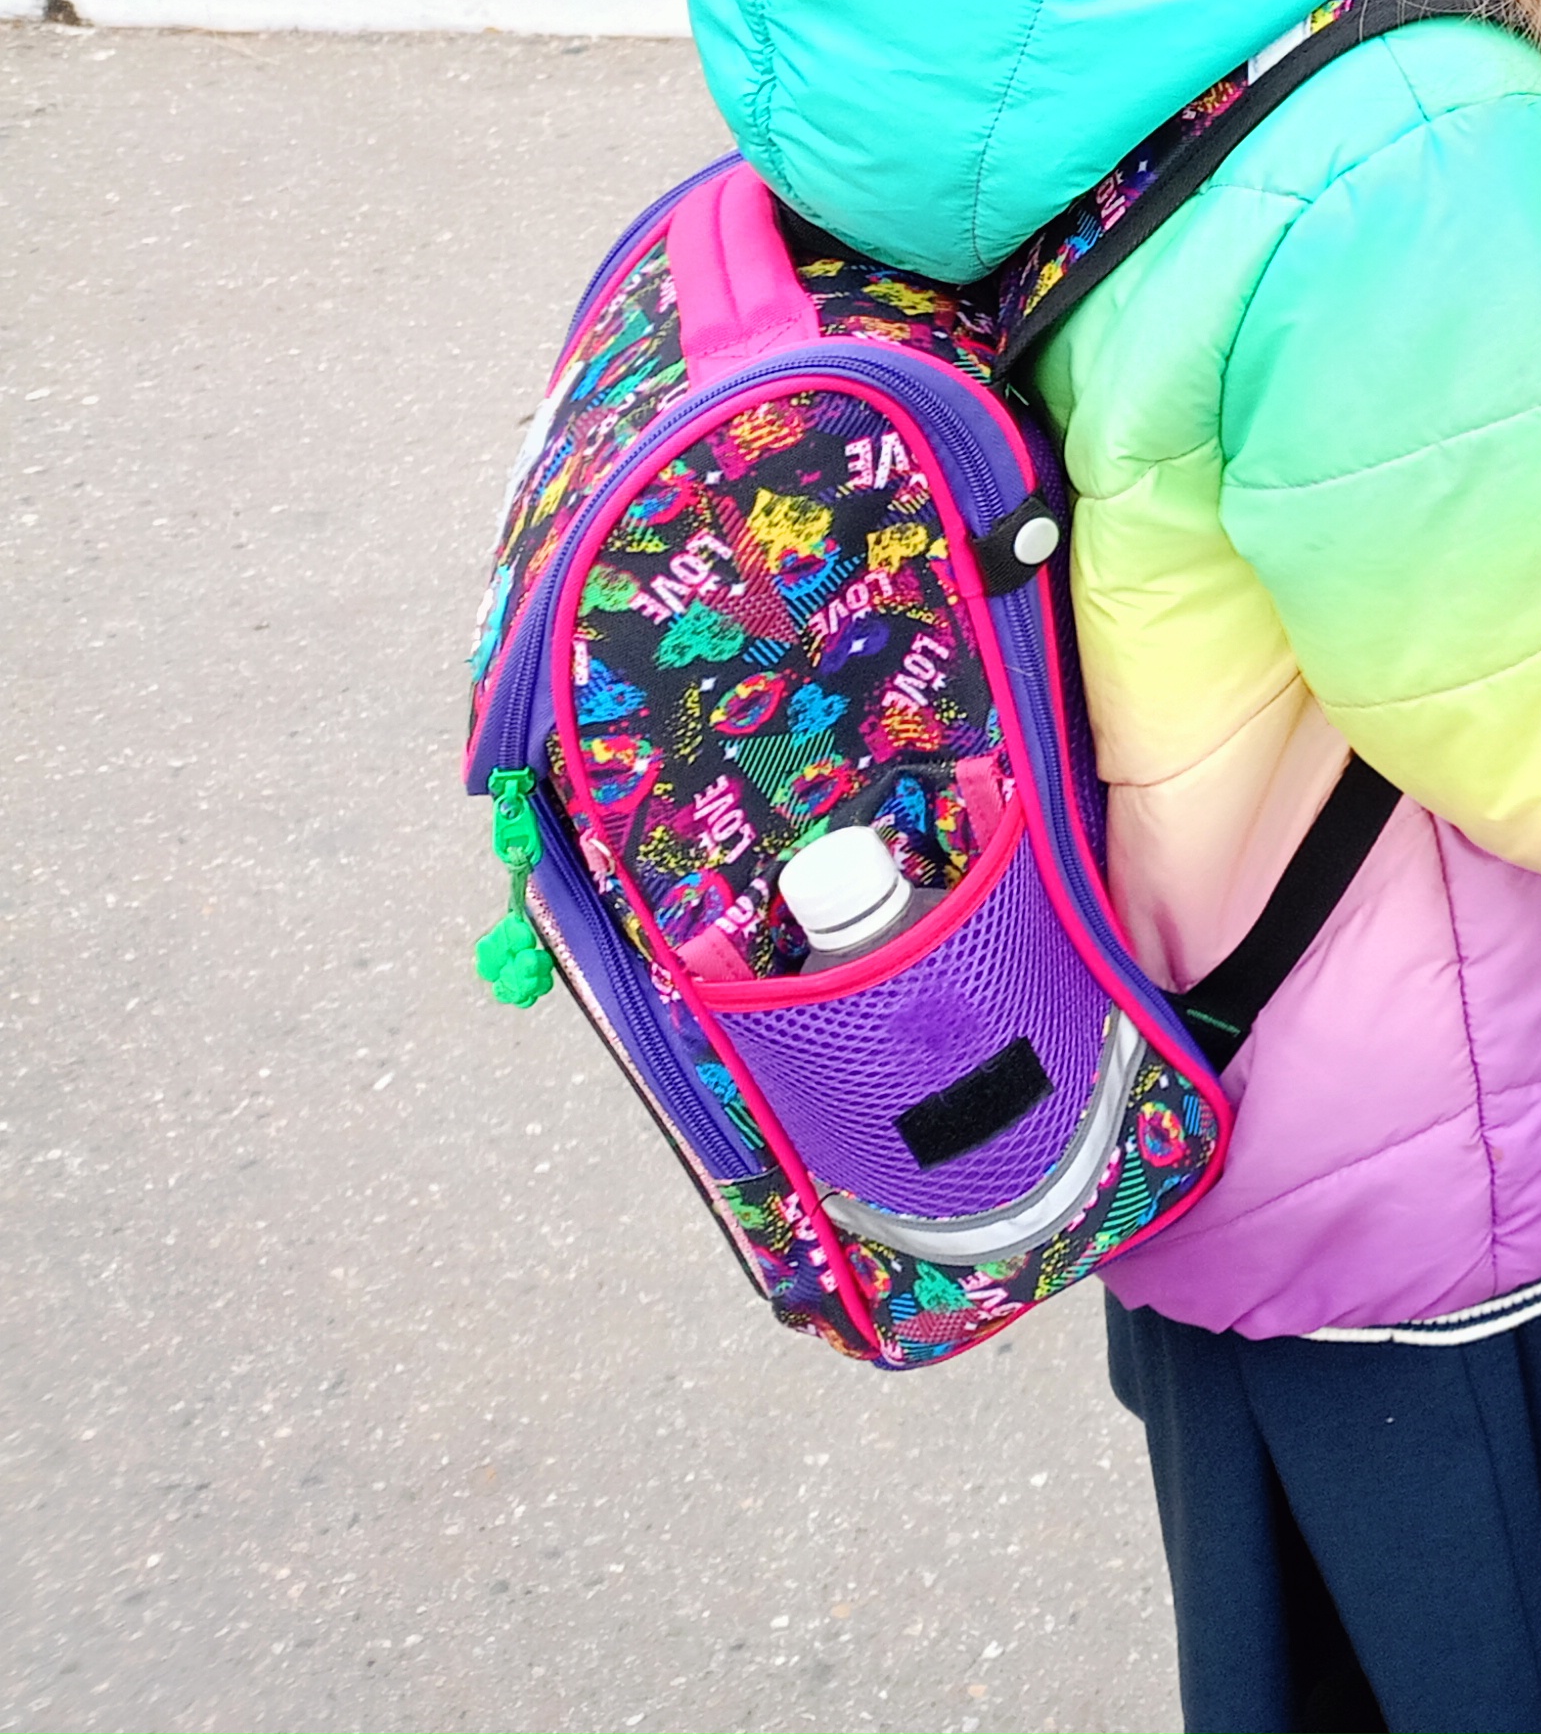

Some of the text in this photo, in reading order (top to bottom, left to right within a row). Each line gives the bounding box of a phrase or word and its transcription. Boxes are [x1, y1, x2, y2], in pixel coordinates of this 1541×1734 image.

[630, 528, 734, 625] LOVE
[808, 567, 893, 638] LOVE
[880, 632, 950, 714] LOVE
[693, 774, 757, 865] LOVE
